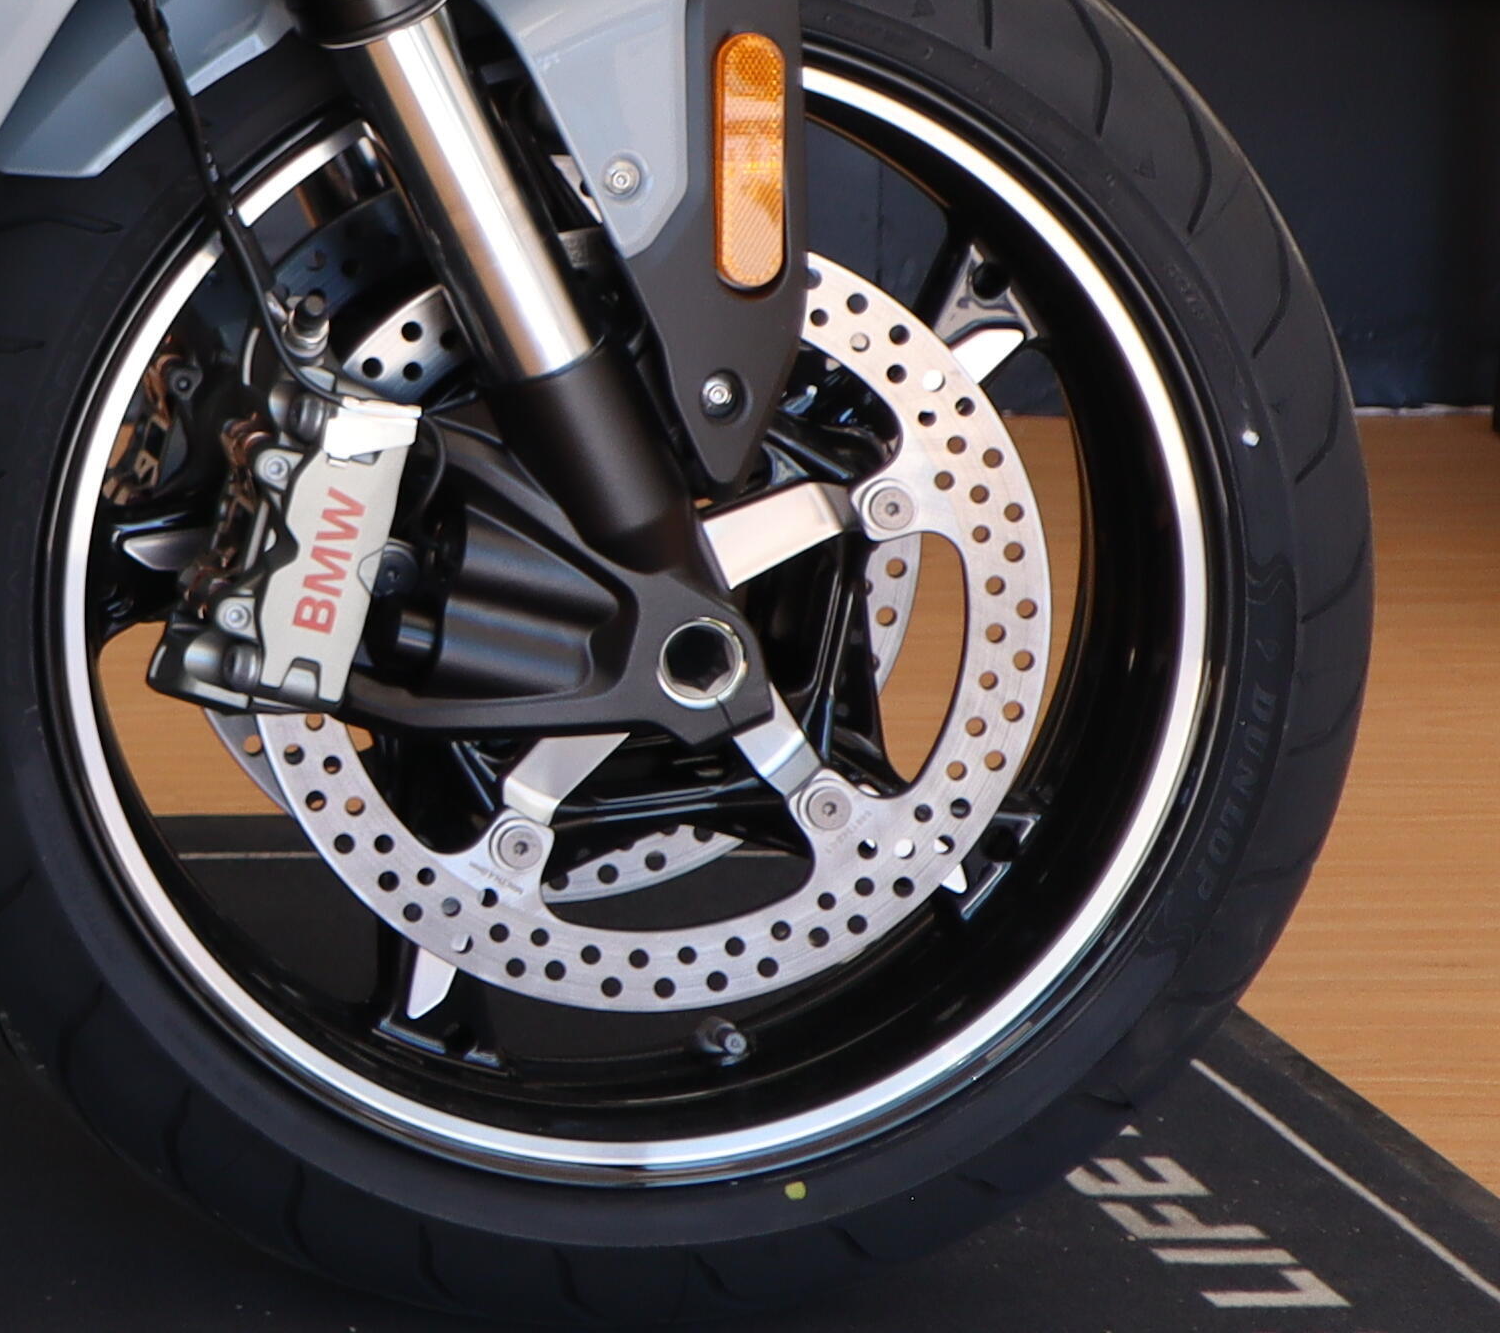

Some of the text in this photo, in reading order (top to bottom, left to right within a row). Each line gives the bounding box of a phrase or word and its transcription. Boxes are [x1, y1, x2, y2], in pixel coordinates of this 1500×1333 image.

[291, 485, 369, 635] BMW
[1195, 682, 1277, 901] DUNLOP
[1064, 1154, 1350, 1308] LIFE
